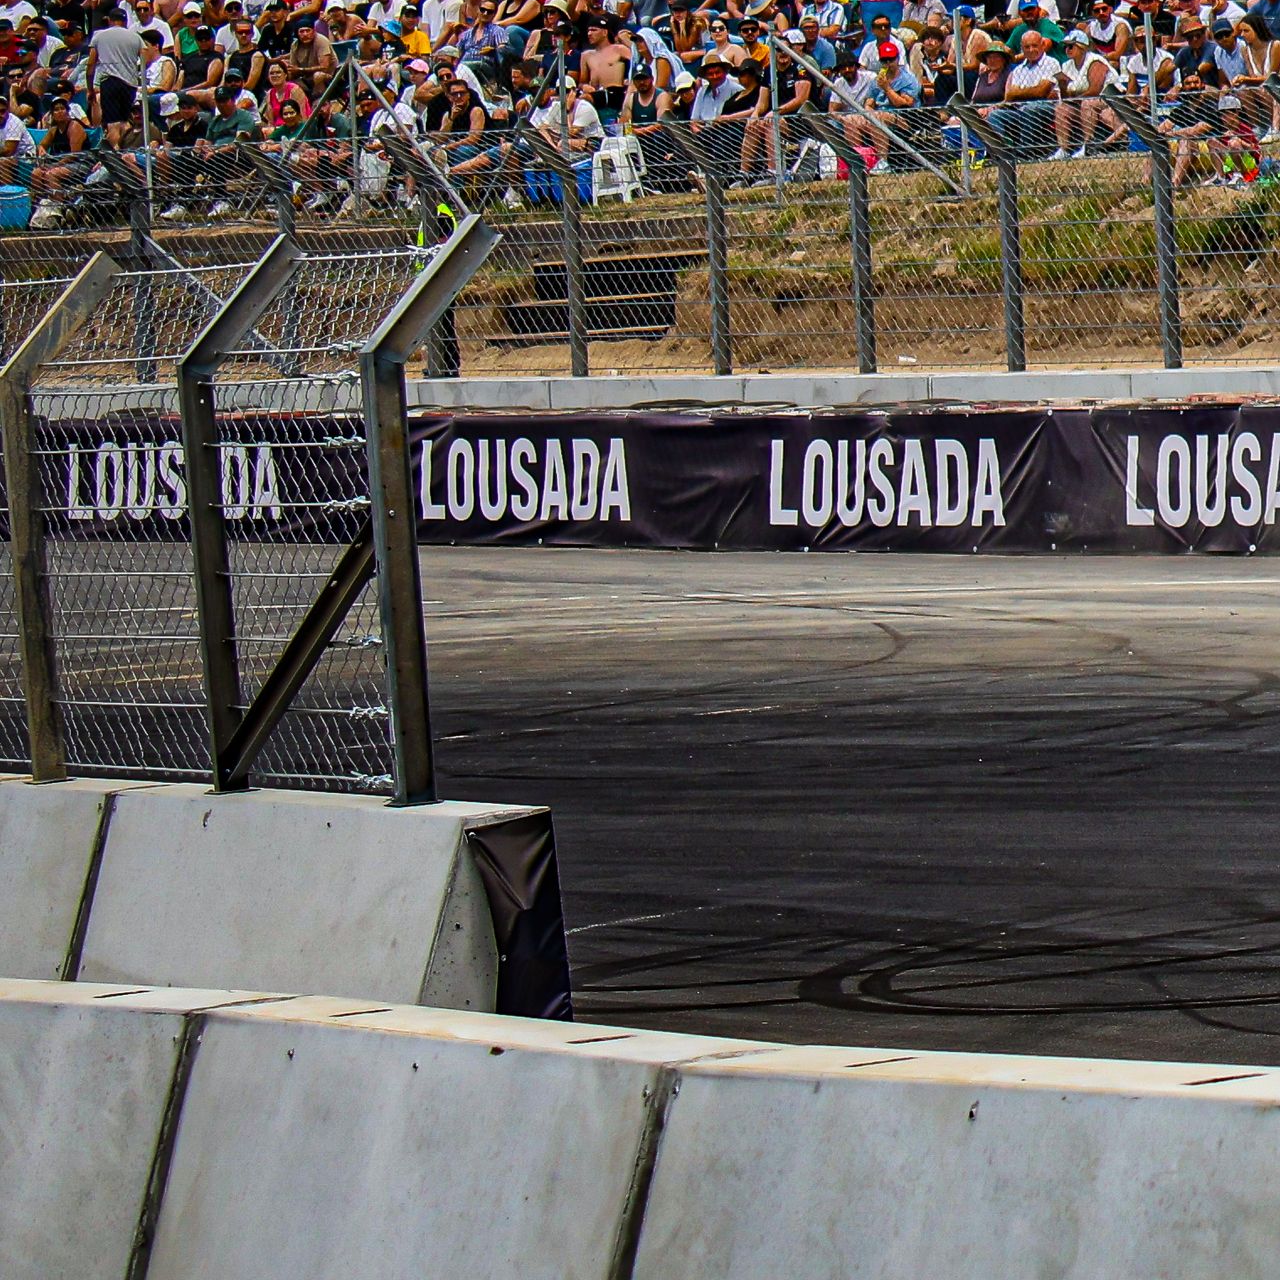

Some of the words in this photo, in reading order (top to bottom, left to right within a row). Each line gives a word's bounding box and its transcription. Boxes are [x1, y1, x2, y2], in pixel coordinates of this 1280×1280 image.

[68, 441, 282, 520] LOUSDA
[421, 437, 631, 522] LOUSADA
[769, 438, 1005, 527] LOUSADA
